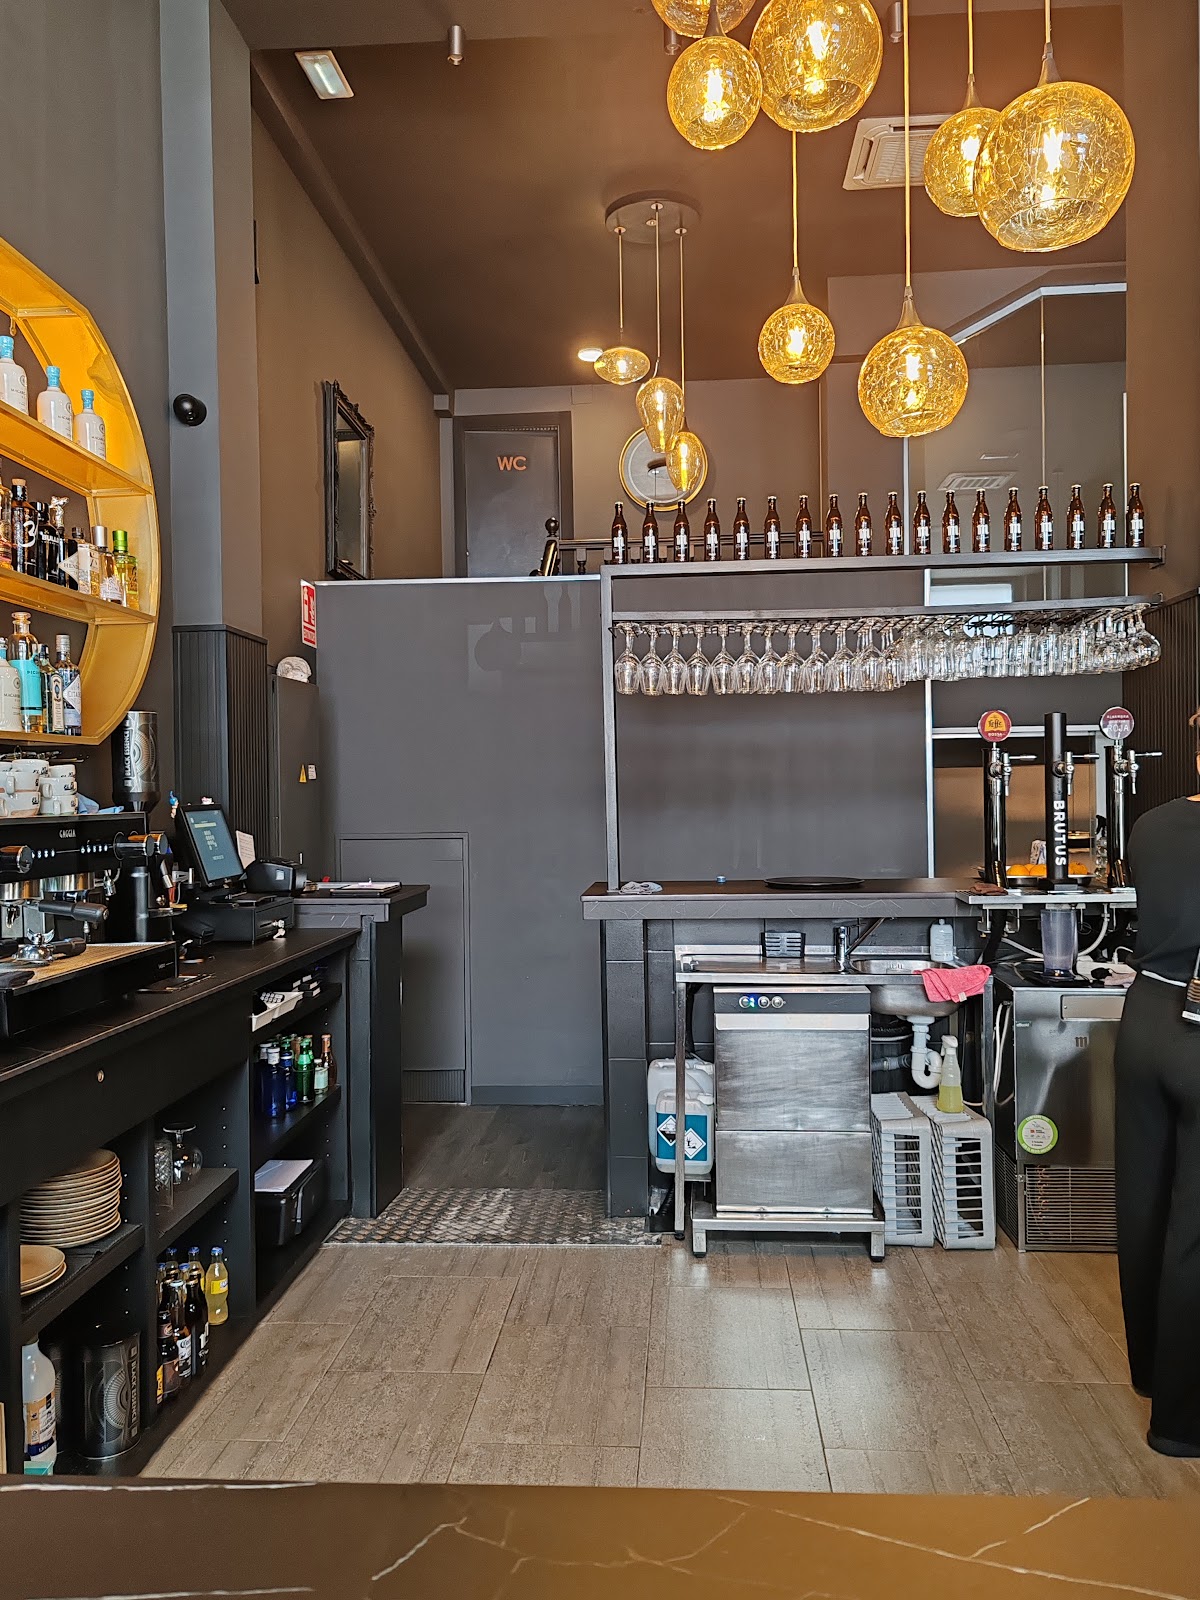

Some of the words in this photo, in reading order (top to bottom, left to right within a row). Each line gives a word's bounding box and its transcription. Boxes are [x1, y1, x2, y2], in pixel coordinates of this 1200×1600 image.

[496, 456, 527, 471] WC
[1107, 724, 1130, 732] ROJA
[123, 730, 131, 755] ESSENCE
[124, 755, 132, 777] BLACK
[1053, 800, 1067, 866] BRUTUS
